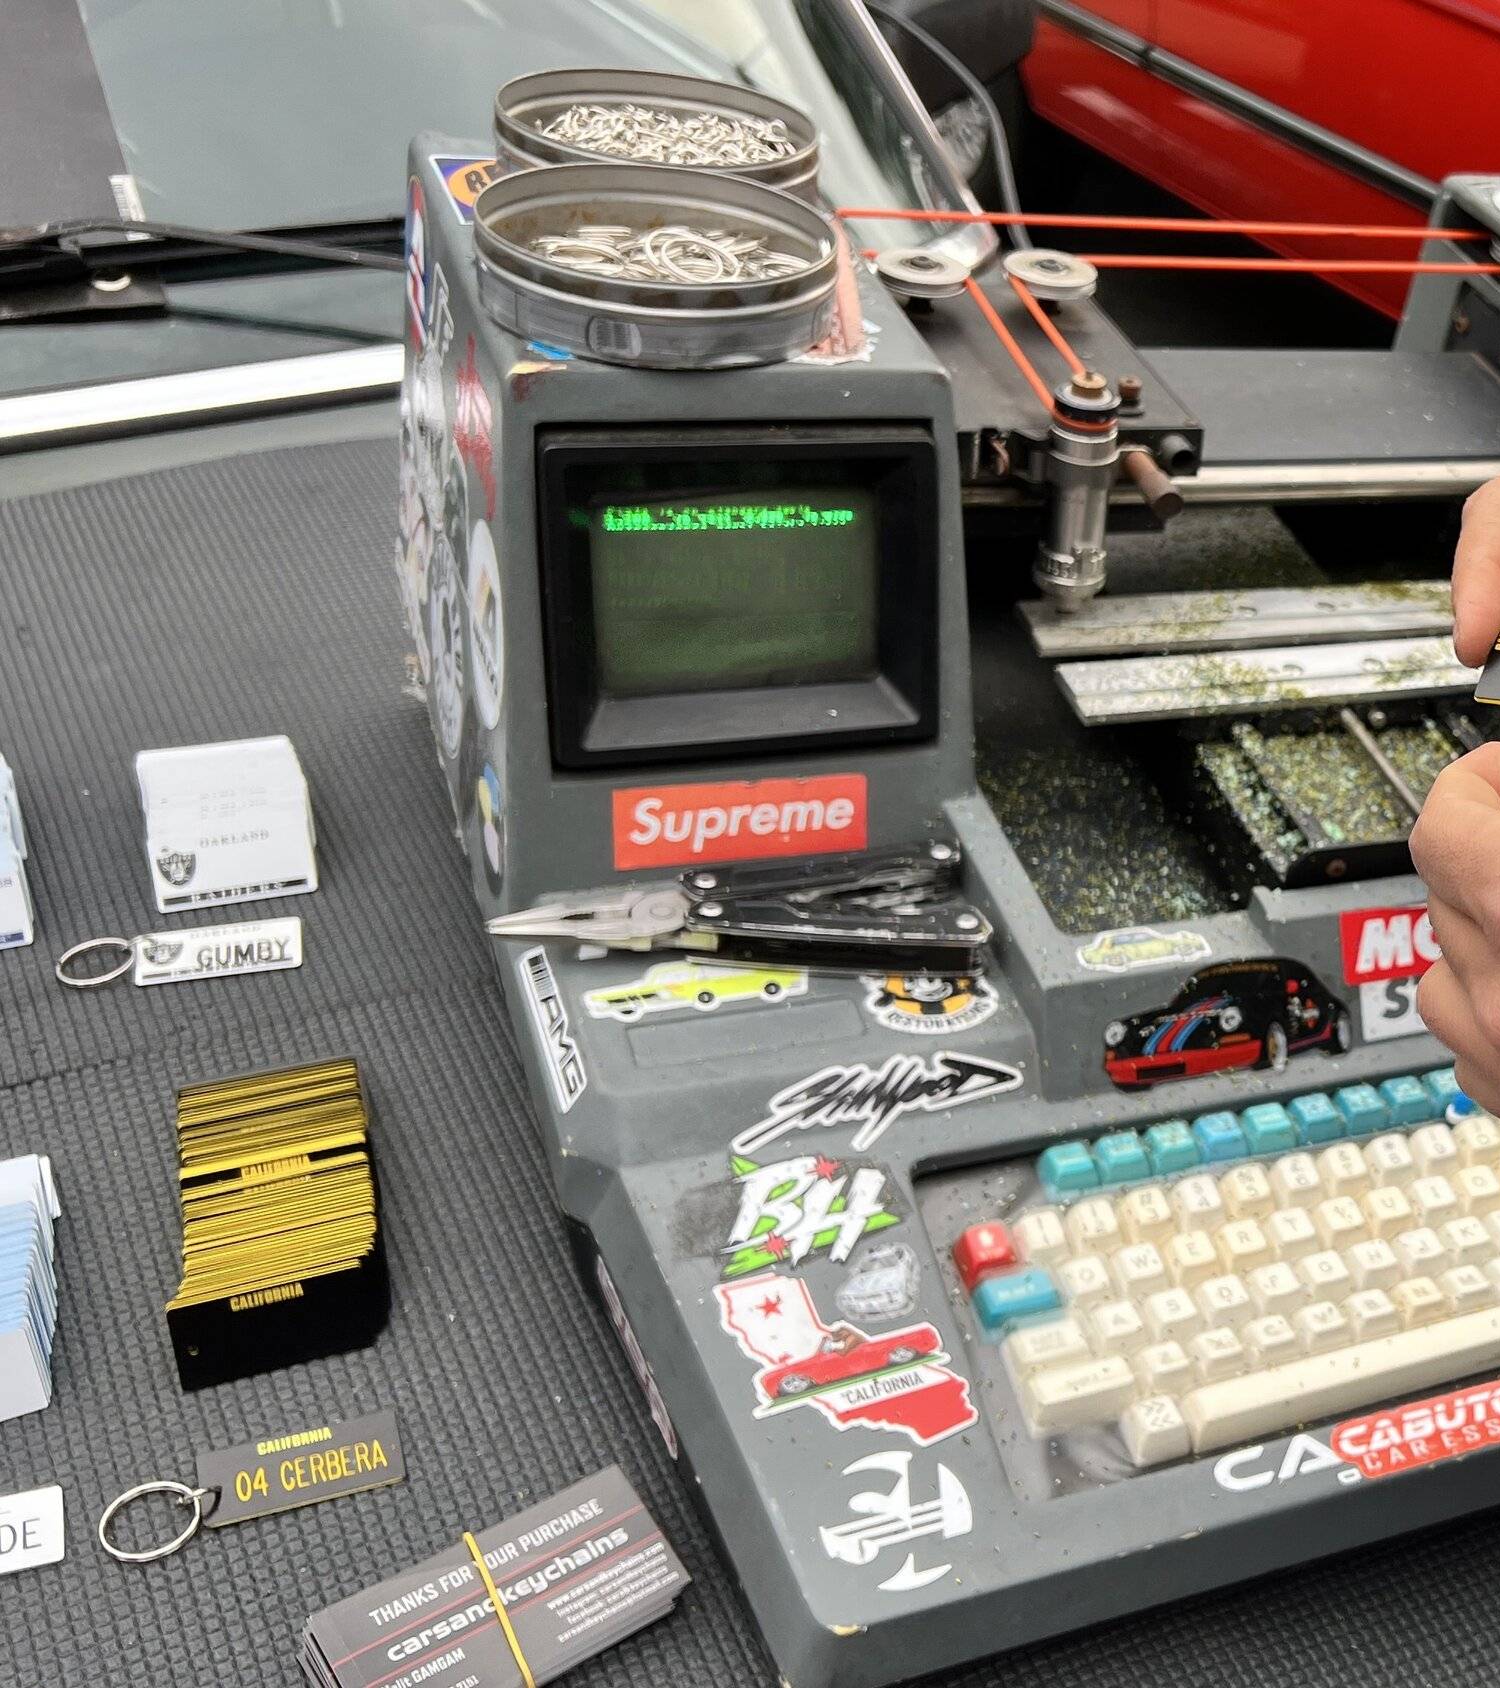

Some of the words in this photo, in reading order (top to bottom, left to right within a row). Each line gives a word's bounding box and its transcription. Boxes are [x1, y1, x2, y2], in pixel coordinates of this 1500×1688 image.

[629, 797, 855, 853] Supreme
[197, 937, 290, 971] GUMBY
[1382, 975, 1421, 1019] S
[540, 994, 585, 1097] AMG
[230, 1282, 304, 1311] CALIFORNIA
[845, 1371, 924, 1404] CALIFORNIA
[256, 1427, 333, 1456] CALIFORNIA
[1360, 1438, 1431, 1473] CAR
[235, 1466, 270, 1502] 04
[280, 1439, 388, 1492] CERBERA
[369, 1583, 440, 1626] THANKS
[438, 1564, 475, 1593] FOR
[517, 1498, 604, 1552] PURCHASE
[411, 1647, 466, 1683] GAMGAM
